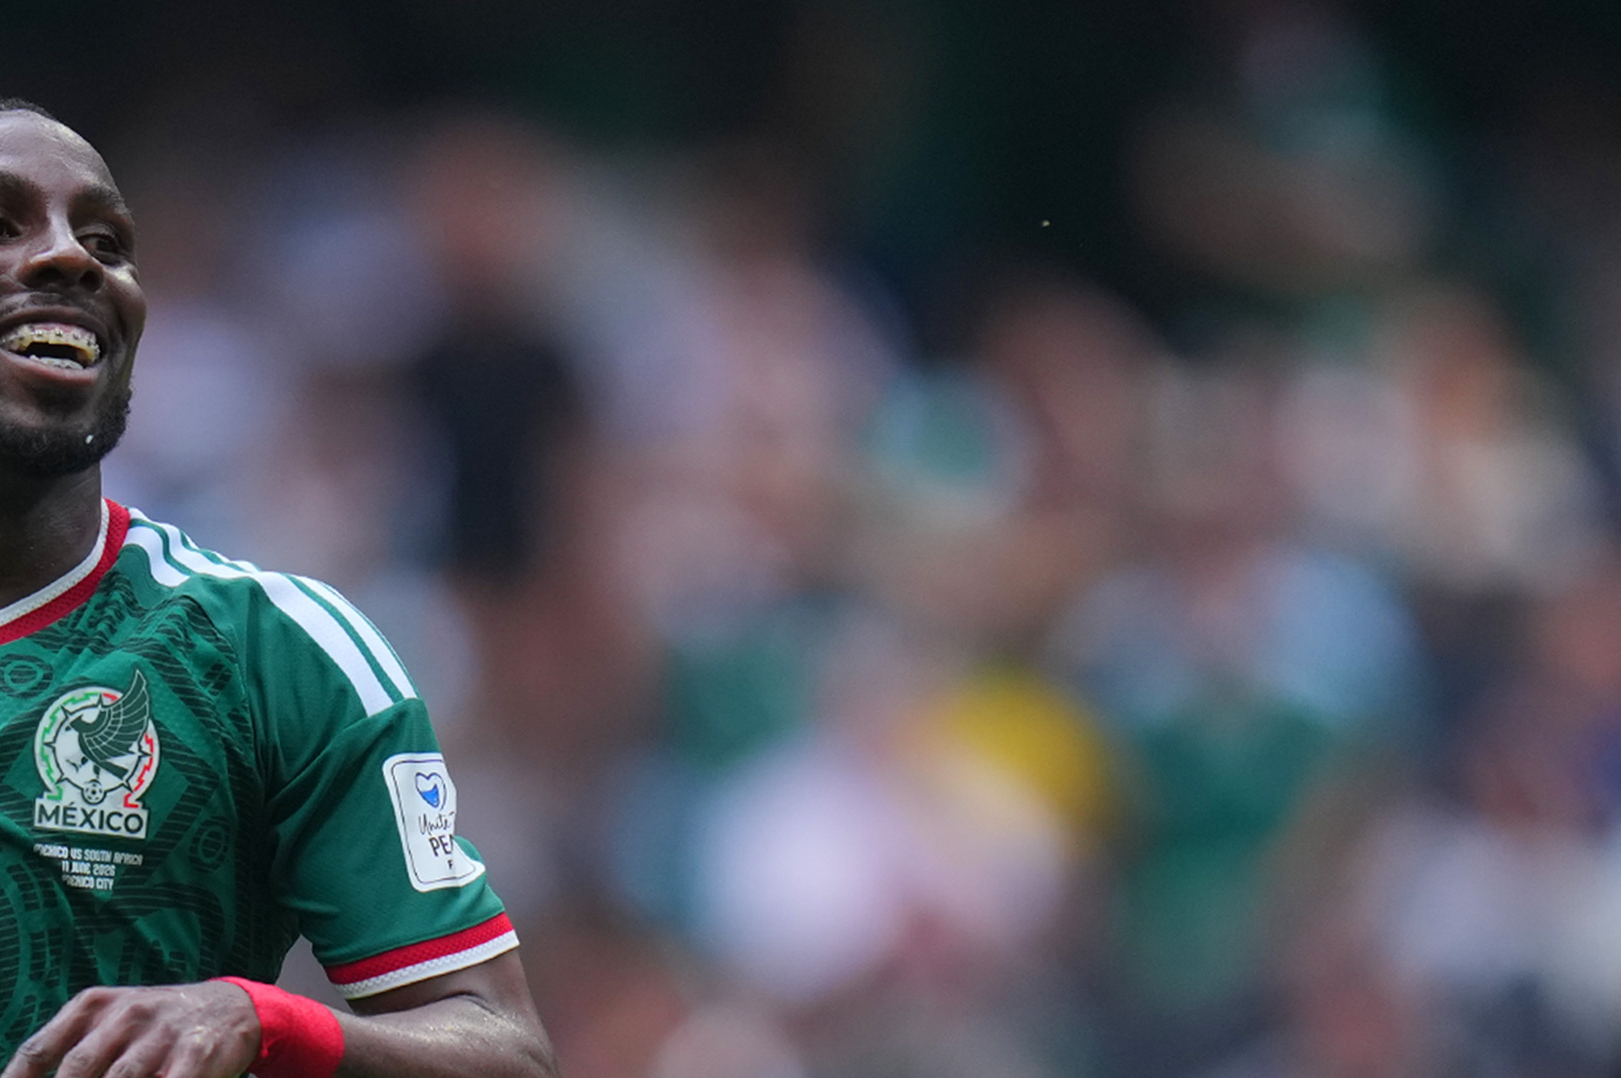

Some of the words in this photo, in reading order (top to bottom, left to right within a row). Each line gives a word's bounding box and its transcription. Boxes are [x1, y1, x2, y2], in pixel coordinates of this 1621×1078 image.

[38, 801, 144, 834] MÉXICO
[84, 848, 112, 863] SOUTH
[61, 860, 69, 872] 11
[71, 861, 91, 875] JUNE
[93, 863, 116, 877] 2026
[96, 876, 114, 890] CITY
